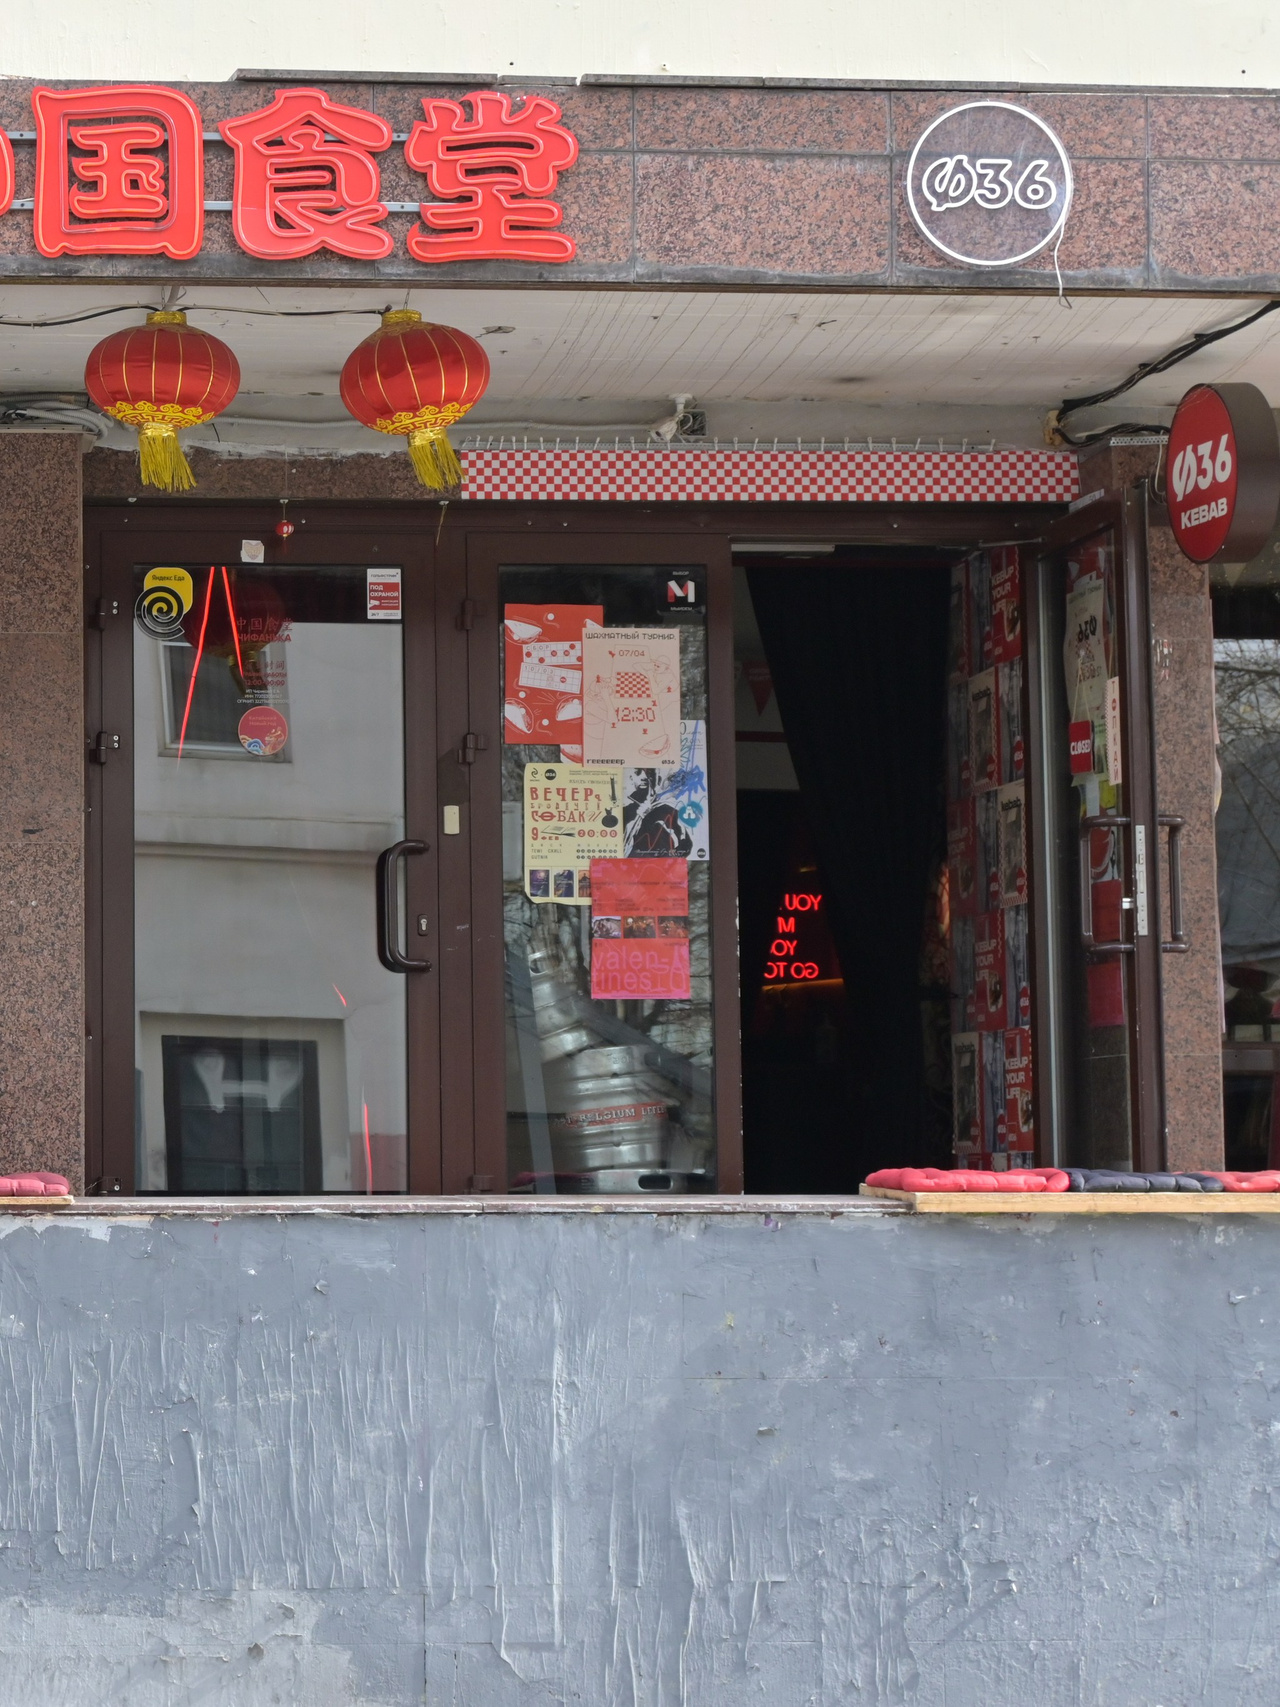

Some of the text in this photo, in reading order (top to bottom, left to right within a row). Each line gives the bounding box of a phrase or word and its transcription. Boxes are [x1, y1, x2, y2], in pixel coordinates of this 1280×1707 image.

[1181, 497, 1228, 530] KEBAB
[585, 631, 639, 640] ШАХМАТНЫЙ
[614, 707, 656, 723] 12:30
[531, 827, 539, 841] 9
[1006, 1071, 1025, 1084] YOUR
